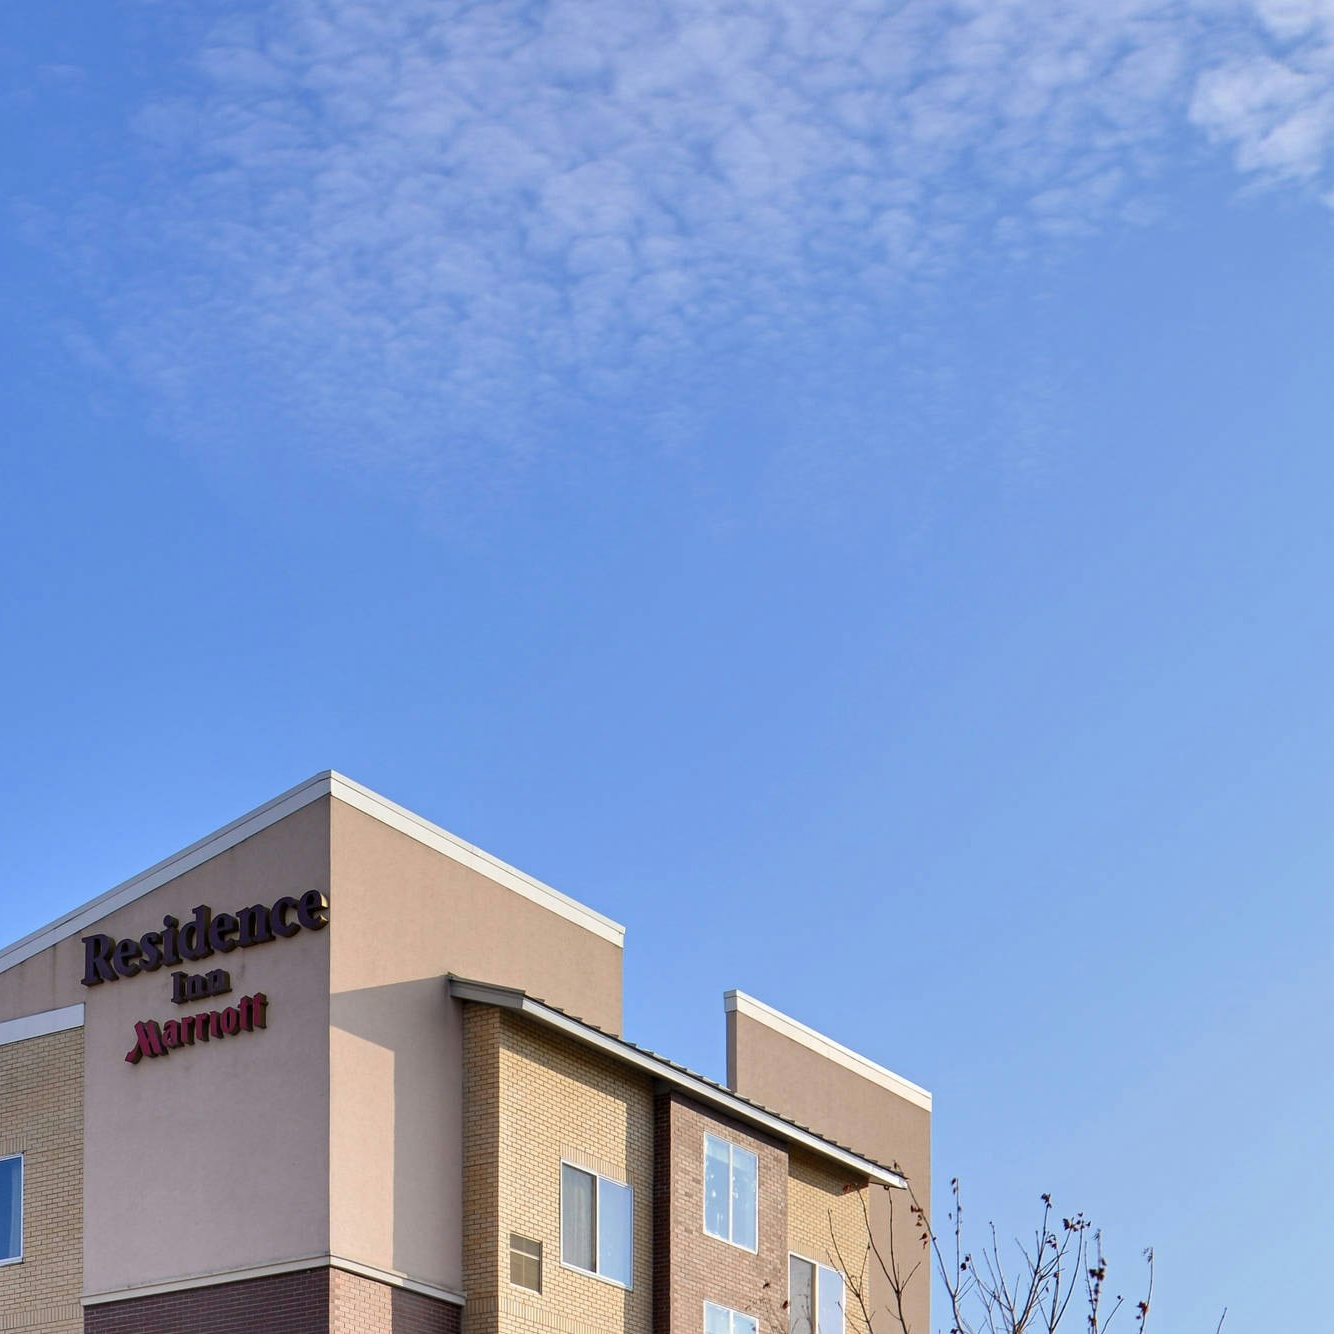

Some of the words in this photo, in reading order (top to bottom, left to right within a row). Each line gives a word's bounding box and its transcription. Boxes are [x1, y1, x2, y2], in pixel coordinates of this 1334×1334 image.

[81, 889, 329, 987] Residence
[171, 968, 232, 1005] Inn
[125, 992, 268, 1064] Marriott
